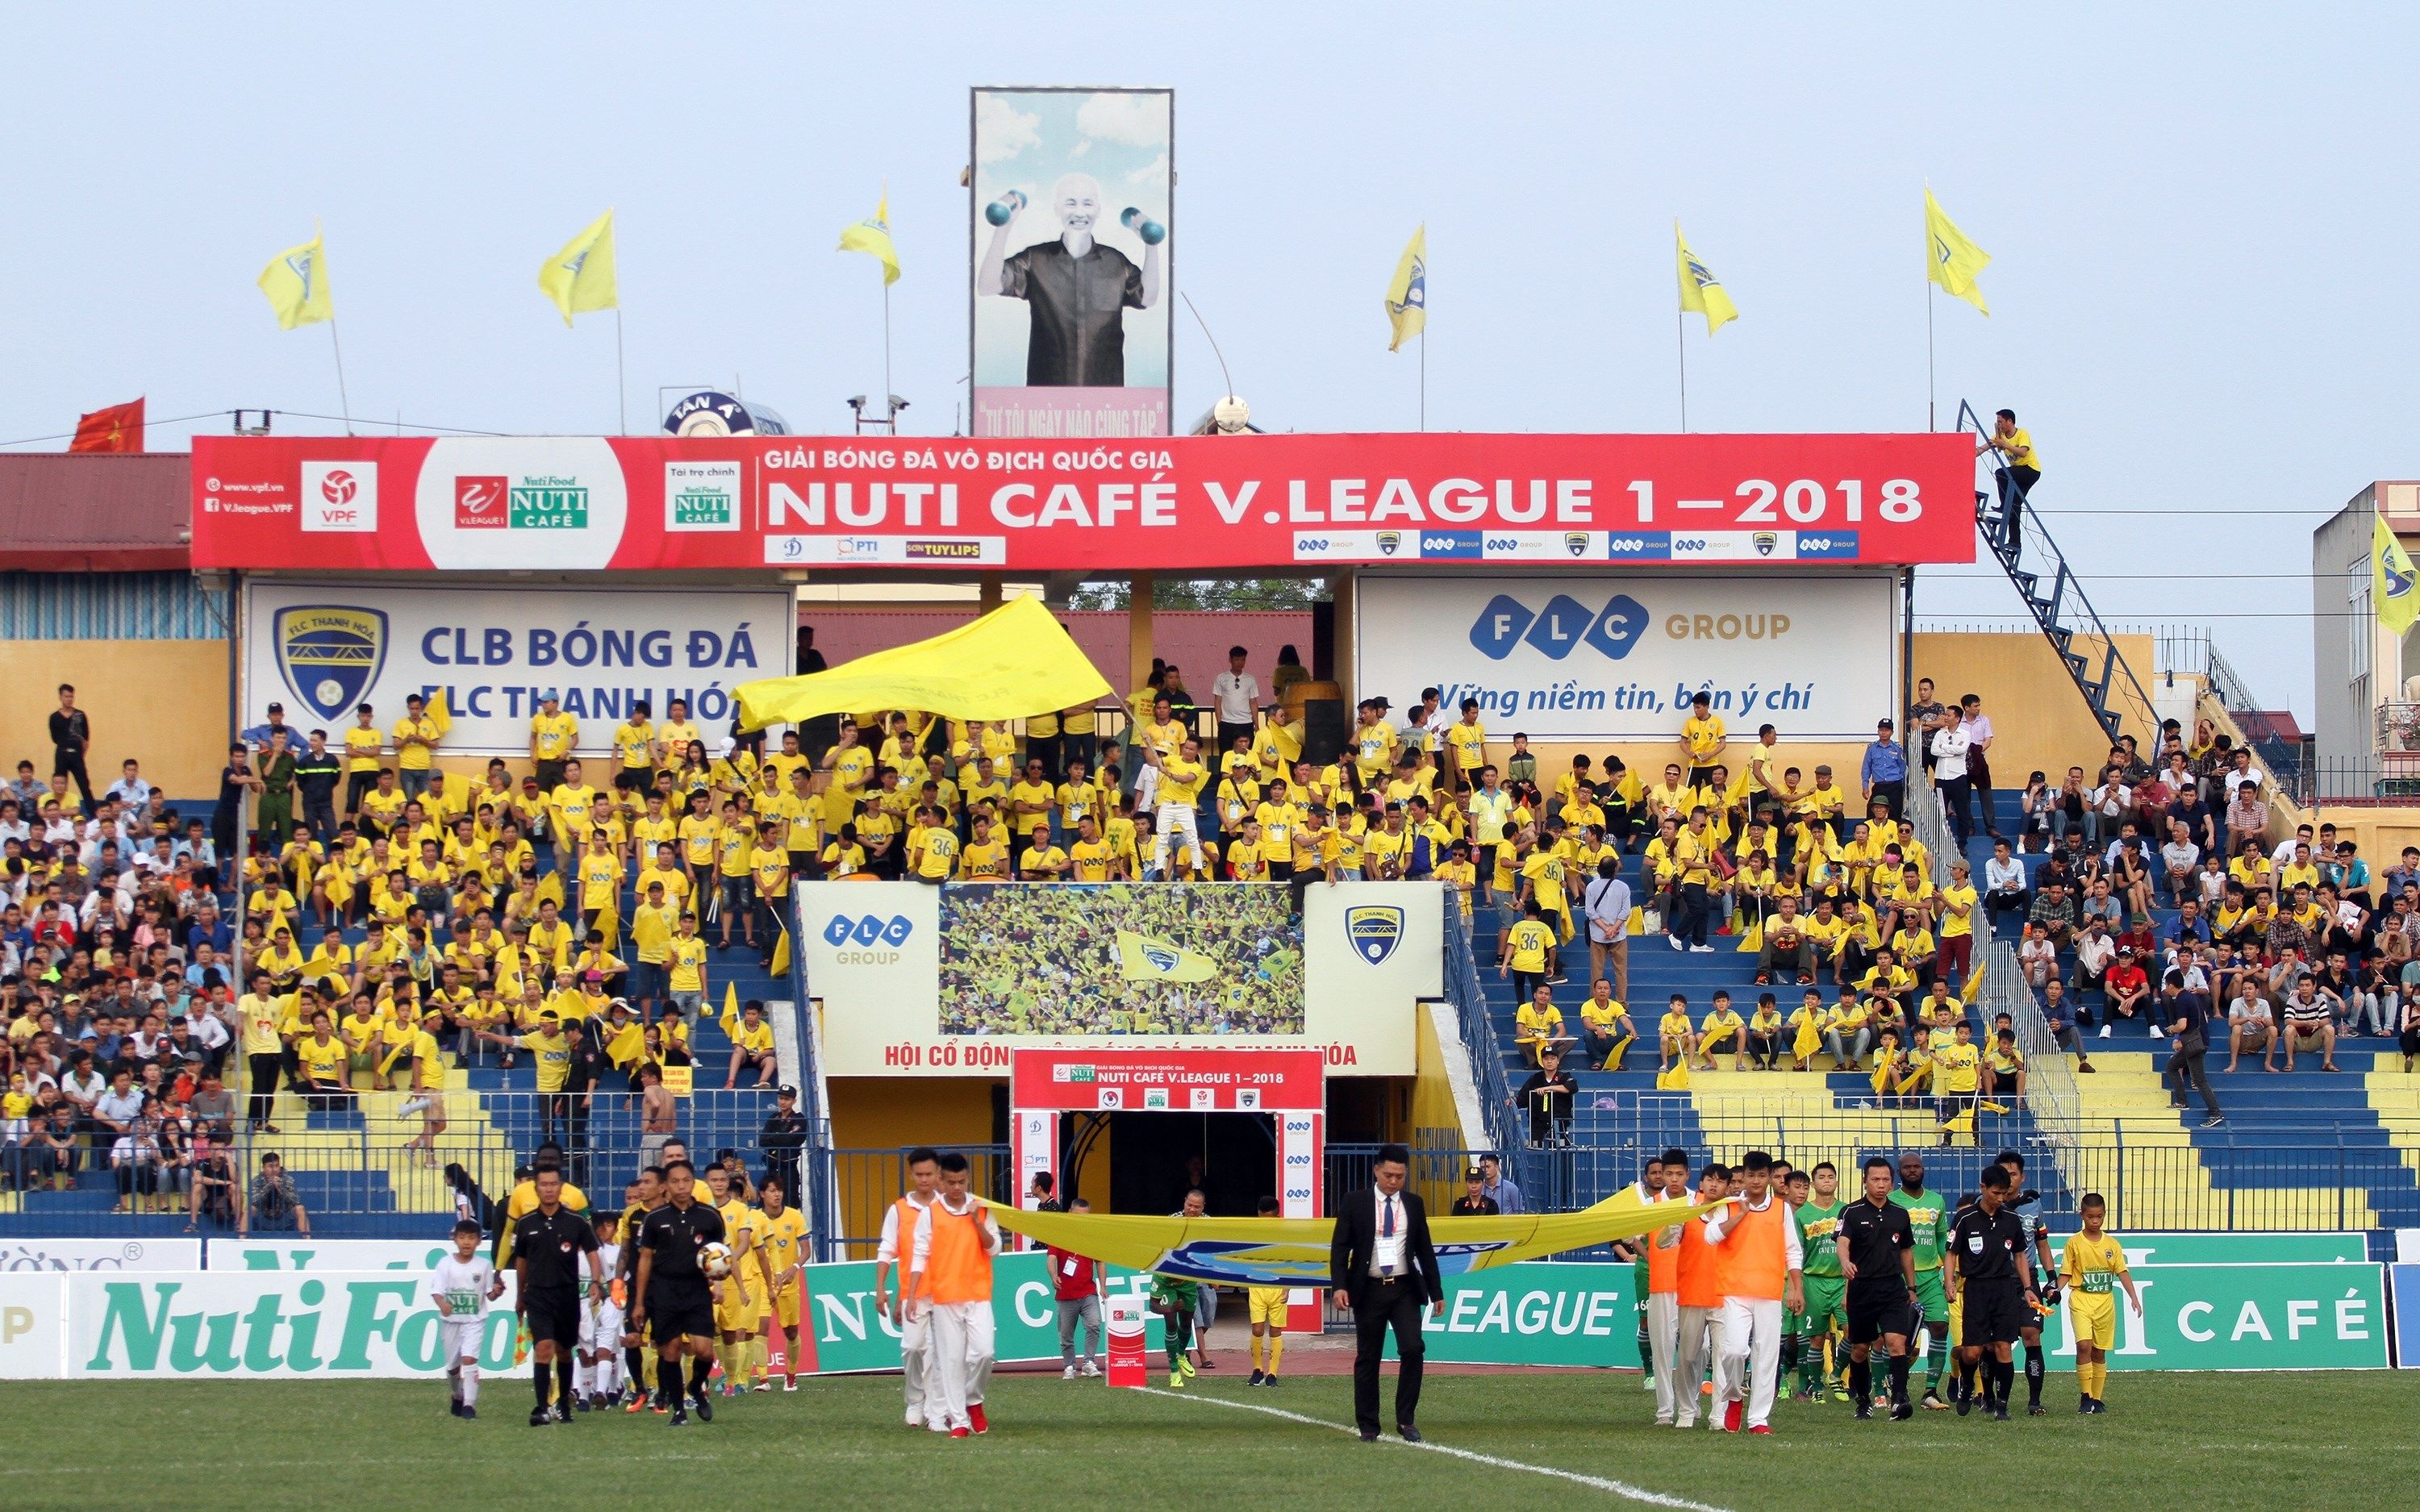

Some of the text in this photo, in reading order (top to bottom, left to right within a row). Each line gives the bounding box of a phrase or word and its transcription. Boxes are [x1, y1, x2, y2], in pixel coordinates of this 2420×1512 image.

[766, 447, 1174, 474] GIẢI BÓNG ĐÁ VÔ ĐỊCH QUỐC GIA
[707, 468, 735, 477] chính
[223, 483, 285, 494] www.vpf.vn
[223, 503, 294, 514] V.league.VPF
[512, 490, 587, 511] NUTI
[676, 495, 729, 511] NUTI
[770, 484, 958, 527] NUTI
[990, 473, 1178, 528] CAFÉ
[1204, 479, 1592, 524] V.LEAGUE
[322, 510, 357, 523] VPF
[525, 513, 573, 527] CAFÉ
[685, 512, 720, 523] CAFÉ
[857, 540, 878, 552] PTI
[924, 544, 980, 556] TUYLIPS
[1666, 614, 1792, 641] GROUP
[424, 621, 758, 669] CLB BÓNG ĐÁ
[421, 681, 741, 720] FLC THANH HÓ
[1437, 682, 1520, 718] Vững
[1527, 679, 1606, 710] niềm
[1614, 682, 1664, 714] tin,
[1738, 682, 1759, 719] ý
[1765, 682, 1815, 710] chí
[933, 838, 952, 857] 36
[1544, 864, 1558, 881] 36
[1520, 932, 1538, 952] 36
[836, 952, 900, 965] GROUP
[885, 1038, 1358, 1071] HỘI CỔ ĐỘN ÓA
[1098, 1073, 1129, 1083] NUTI
[1133, 1070, 1164, 1083] CAFÉ
[1167, 1073, 1231, 1084] V.LEAGUE
[2086, 1284, 2109, 1293] CAFÉ
[444, 1294, 477, 1306] NUT
[1805, 1315, 1813, 1330] 2
[2179, 1289, 2369, 1343] CAFÉ
[86, 1279, 539, 1372] NutiFoo
